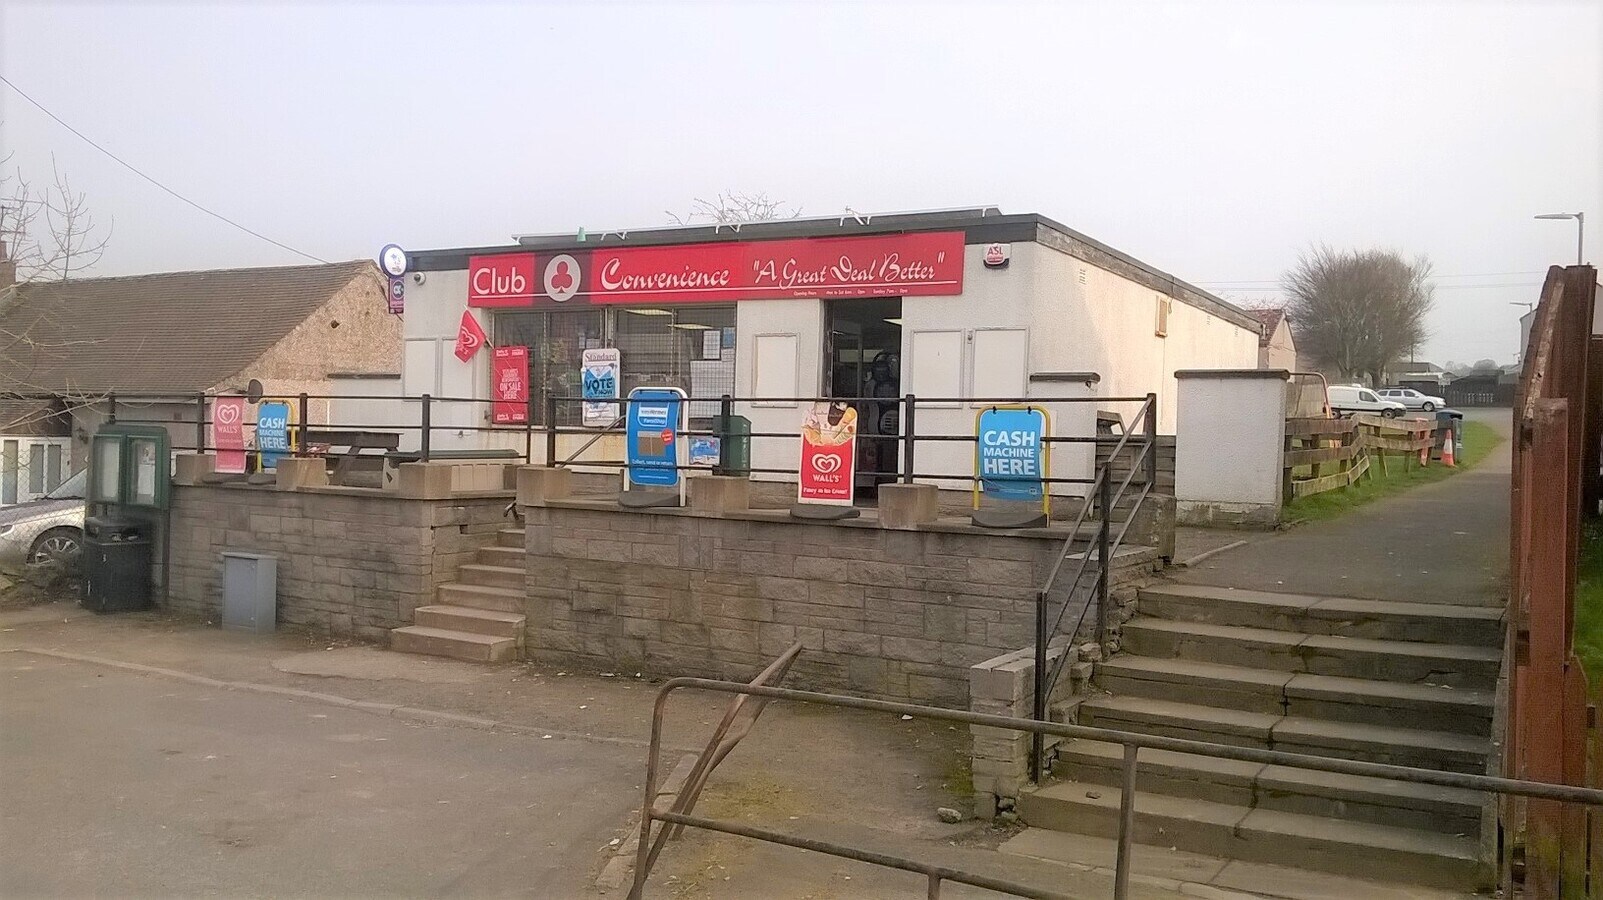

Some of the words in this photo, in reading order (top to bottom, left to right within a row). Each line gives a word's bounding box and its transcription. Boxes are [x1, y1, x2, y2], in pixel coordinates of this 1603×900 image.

[987, 245, 1004, 256] ASL
[602, 257, 730, 290] Convenience
[779, 258, 827, 289] Great
[830, 256, 875, 281] Deal
[472, 267, 526, 295] Club
[508, 382, 522, 391] SALE
[585, 378, 613, 391] VOTE
[259, 417, 285, 429] CASH
[259, 429, 284, 437] MACHINE
[984, 430, 1036, 447] CASH
[259, 437, 286, 449] HERE
[983, 447, 1035, 458] MACHINE
[984, 458, 1036, 476] HERE
[812, 474, 840, 483] WALL'S
